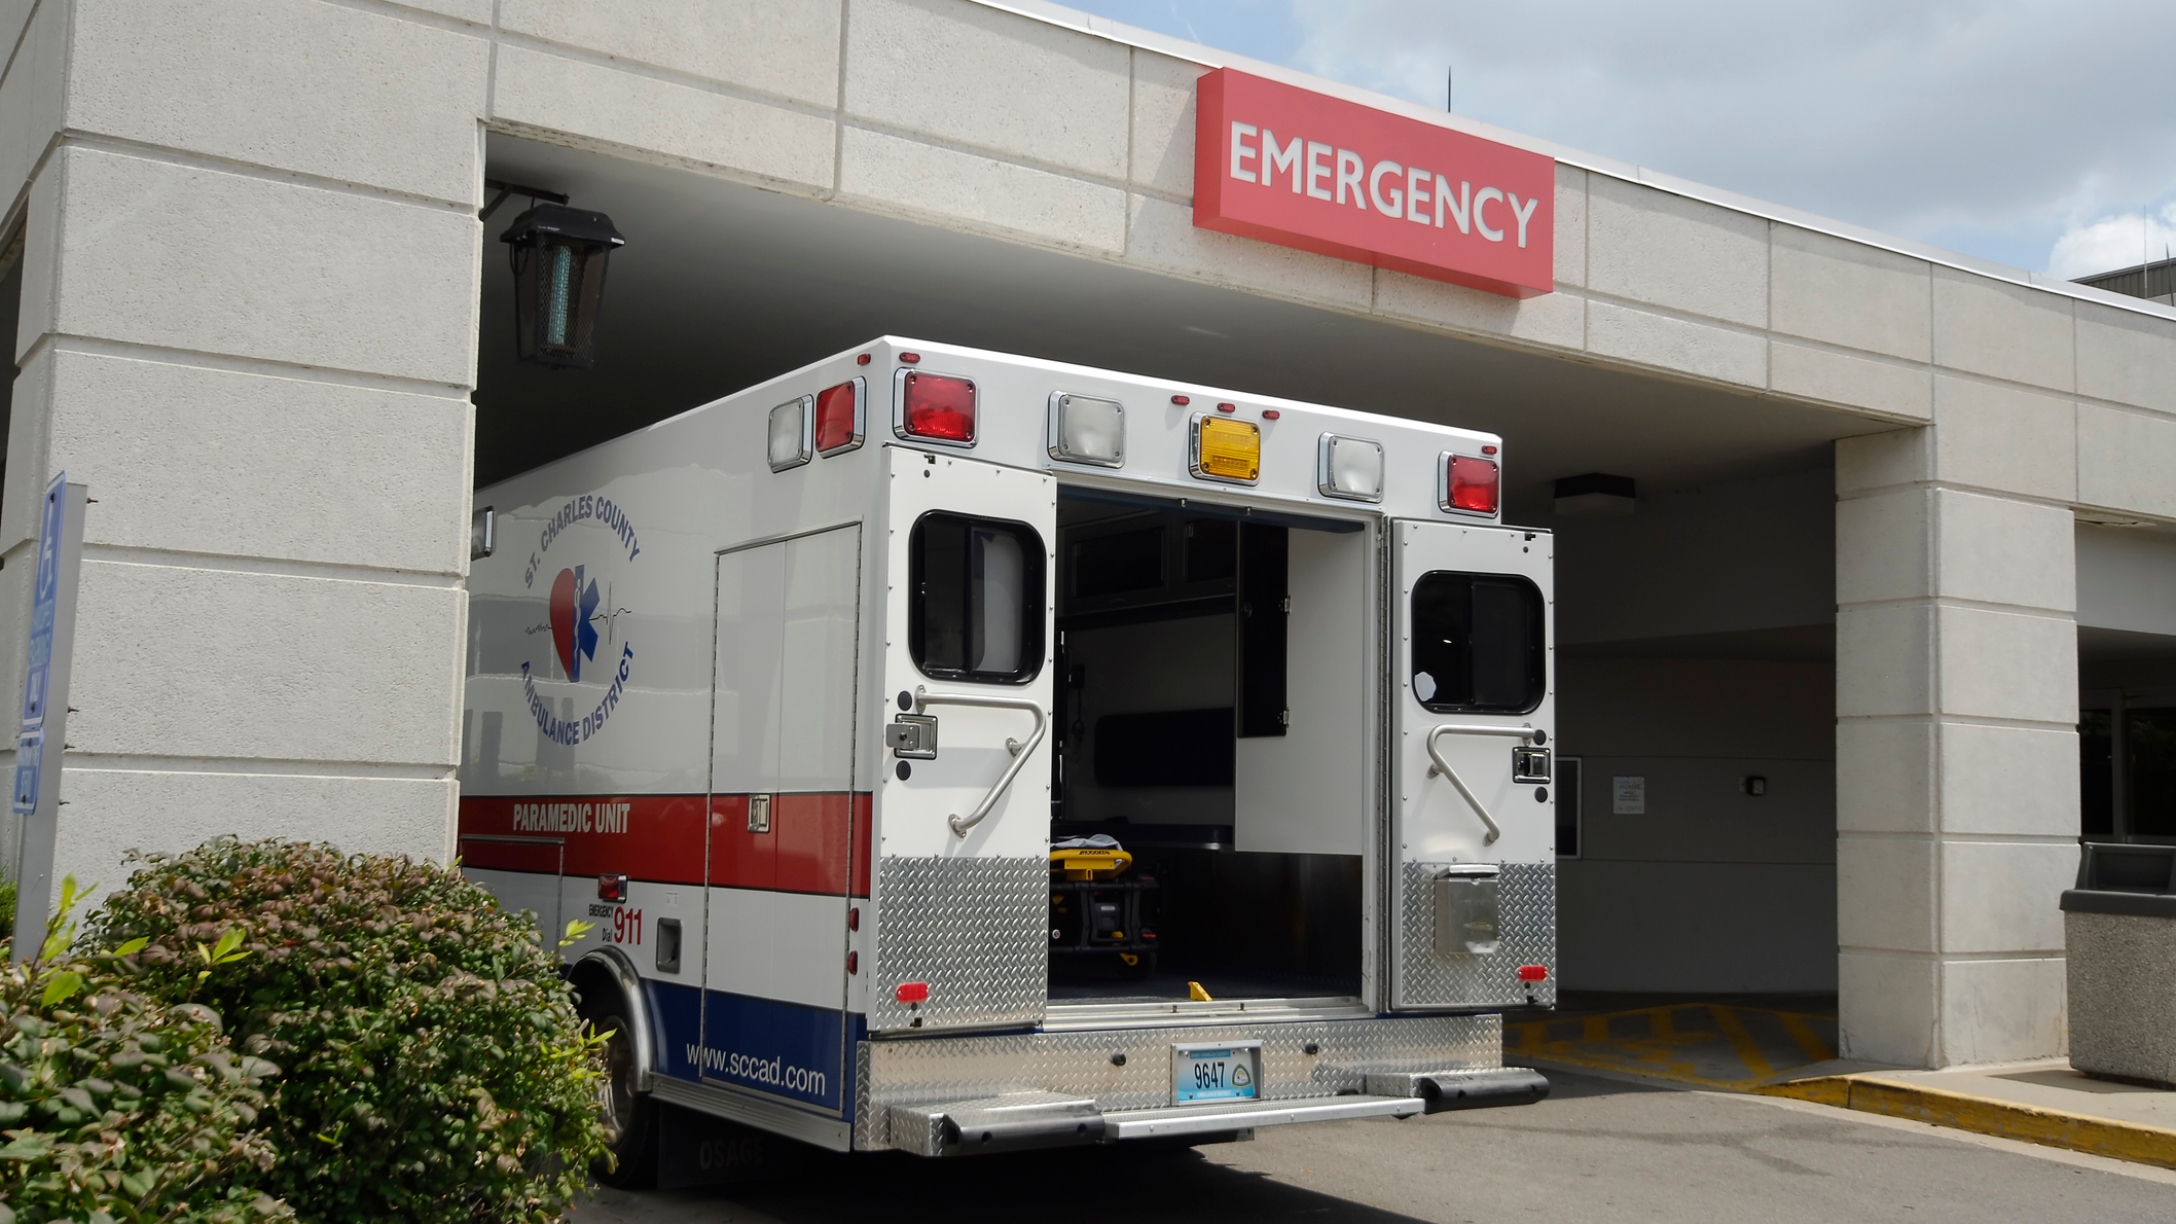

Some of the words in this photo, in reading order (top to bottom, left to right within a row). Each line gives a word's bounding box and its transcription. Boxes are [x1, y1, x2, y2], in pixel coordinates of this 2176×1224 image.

[1230, 120, 1539, 249] EMERGENCY
[525, 552, 541, 590] ST.
[541, 495, 593, 552] CHARLES
[595, 496, 640, 562] COUNTY
[521, 661, 580, 746] AMBULANCE
[582, 641, 634, 741] DISTRICT
[513, 803, 592, 833] PARAMEDIC
[595, 803, 631, 833] UNIT
[614, 905, 643, 945] 911
[686, 1043, 826, 1096] www.sccad.com
[1194, 1061, 1225, 1090] 9647
[699, 1136, 764, 1170] OSAGE
